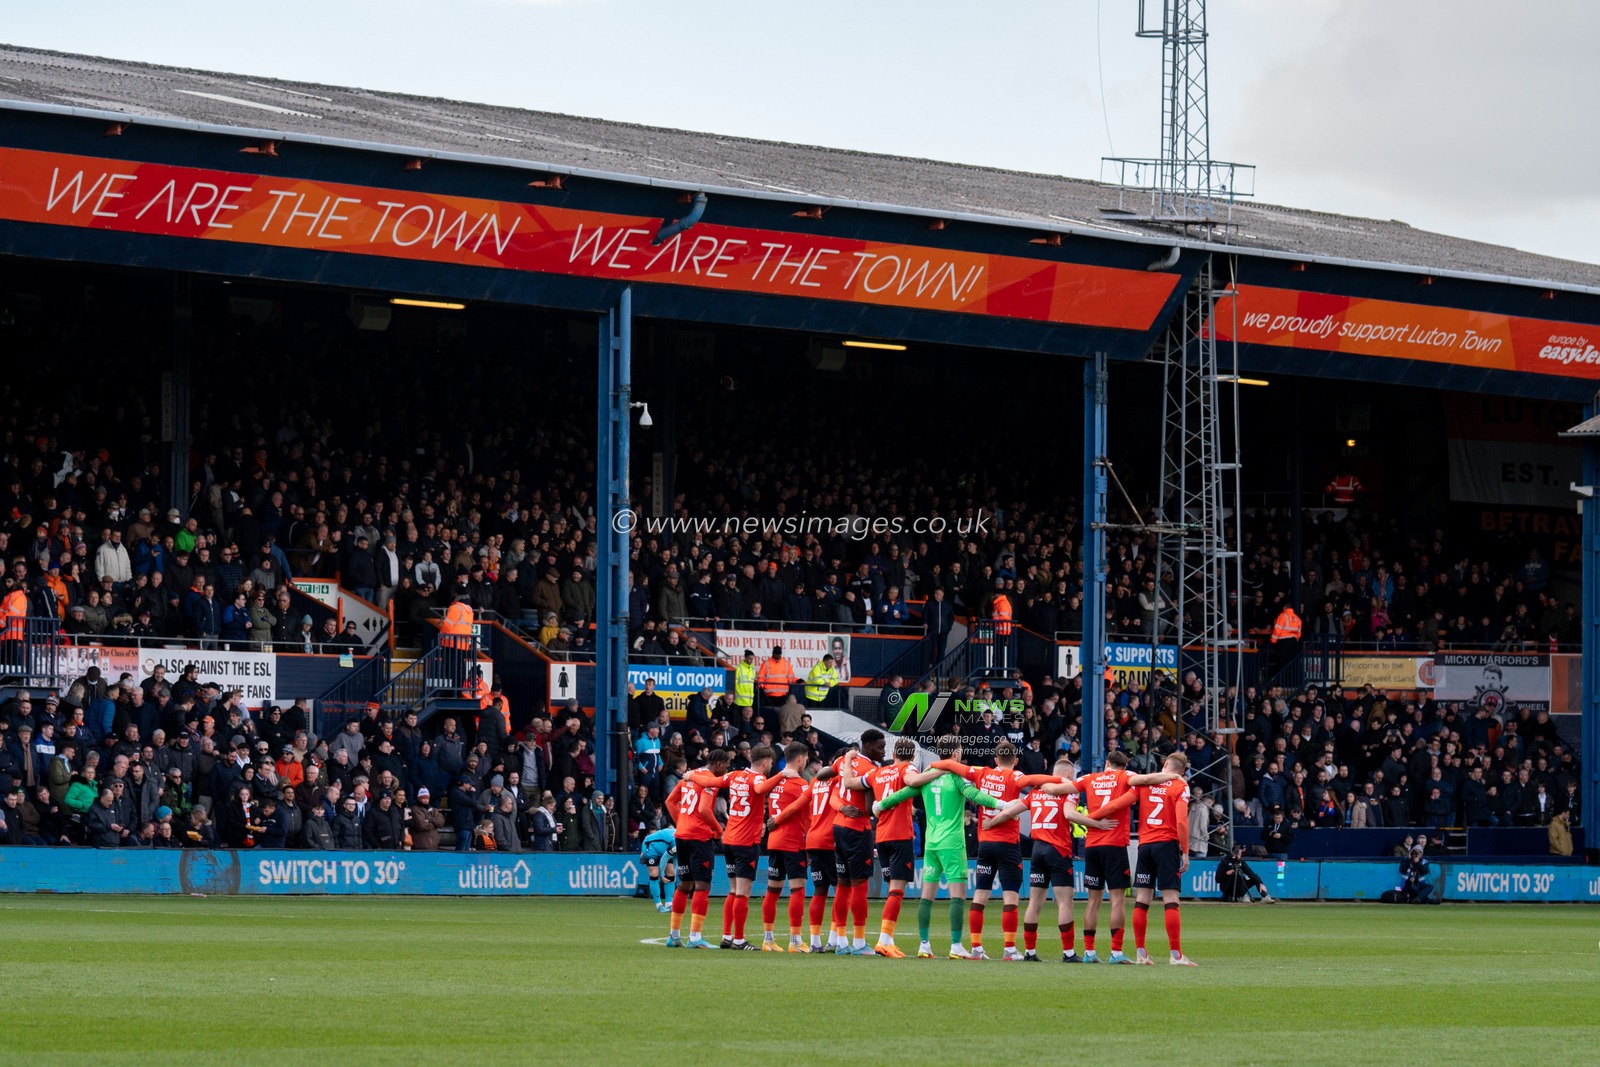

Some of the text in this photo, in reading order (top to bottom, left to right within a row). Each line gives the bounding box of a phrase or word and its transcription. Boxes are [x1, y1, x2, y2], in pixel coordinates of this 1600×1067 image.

[46, 167, 521, 256] WE ARE THE TOWN
[568, 223, 984, 303] WE ARE THE TOWN!
[1242, 311, 1502, 353] we proudly support Luton Town
[1549, 335, 1589, 347] europe by
[1502, 463, 1559, 486] EST.
[717, 636, 828, 651] WHO PUT THE BALL IN
[1115, 646, 1175, 665] SUPPORTS
[1344, 661, 1381, 670] Welcome
[1444, 655, 1540, 665] MICKY HARFORD'S
[232, 661, 251, 676] THE
[253, 662, 272, 677] ESL
[676, 672, 723, 688] опори
[1112, 670, 1153, 686] KRAIN
[1345, 675, 1415, 684] Gary Sweet stand
[247, 684, 272, 698] FANS
[812, 786, 830, 816] 17
[931, 787, 942, 816] 1
[1146, 795, 1164, 825] 2
[1031, 800, 1059, 830] 22
[259, 860, 406, 884] SWITCH TO 30°
[458, 864, 512, 888] utilita
[568, 865, 621, 888] utilita
[1457, 872, 1555, 893] SWITCH TO 30°
